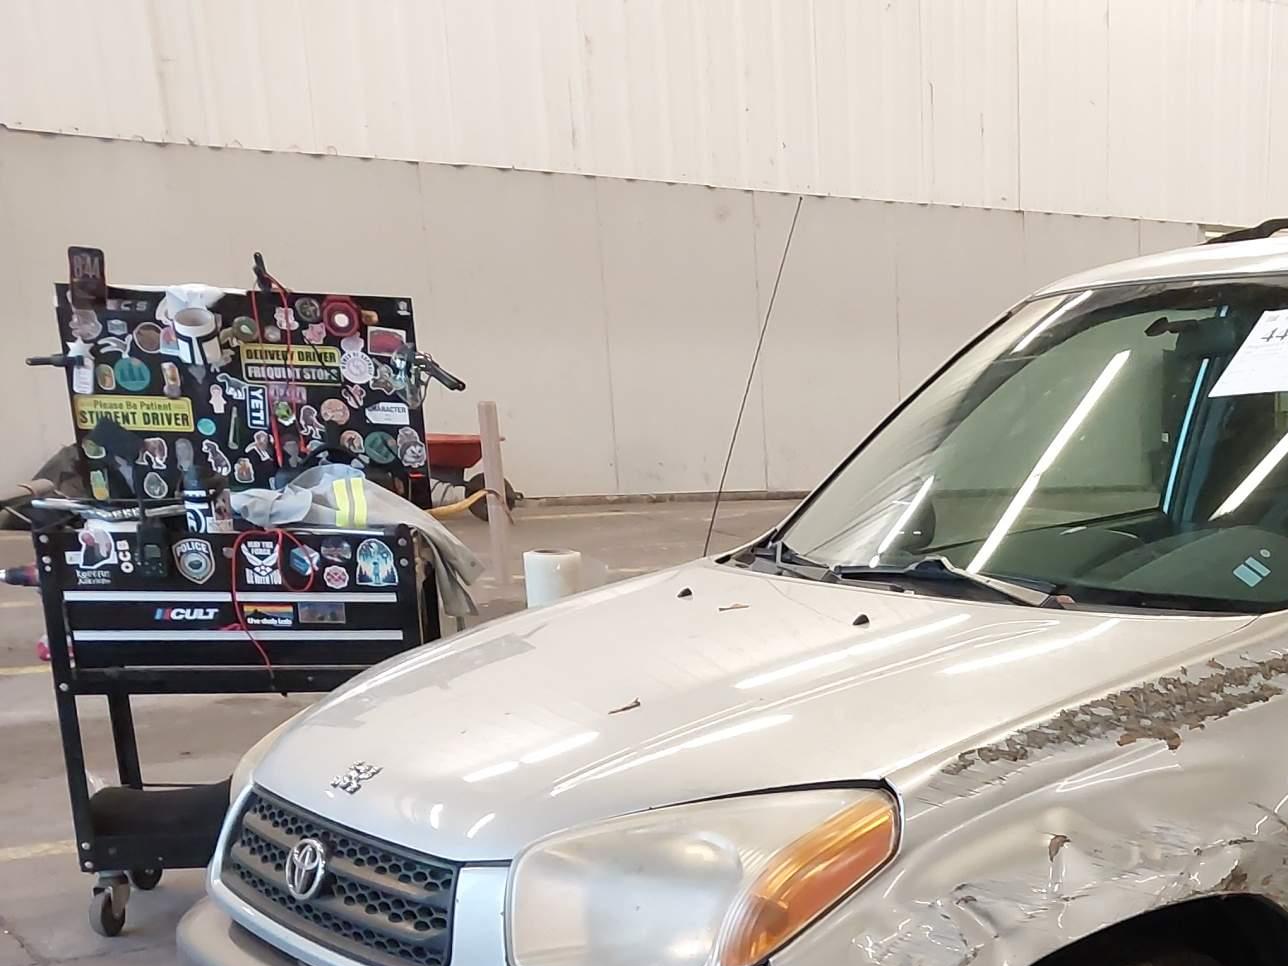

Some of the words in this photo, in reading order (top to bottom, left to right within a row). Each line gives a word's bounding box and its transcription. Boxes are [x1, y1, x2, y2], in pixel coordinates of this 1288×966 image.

[246, 349, 295, 361] DELIVERY
[297, 351, 337, 363] DRIVER
[303, 368, 338, 381] STOPS
[94, 400, 123, 410] Please
[125, 401, 137, 410] Be
[140, 401, 172, 410] Patient
[250, 388, 265, 426] YETI
[142, 412, 190, 427] DRIVER
[175, 541, 209, 557] POLICE
[170, 608, 218, 620] CULT
